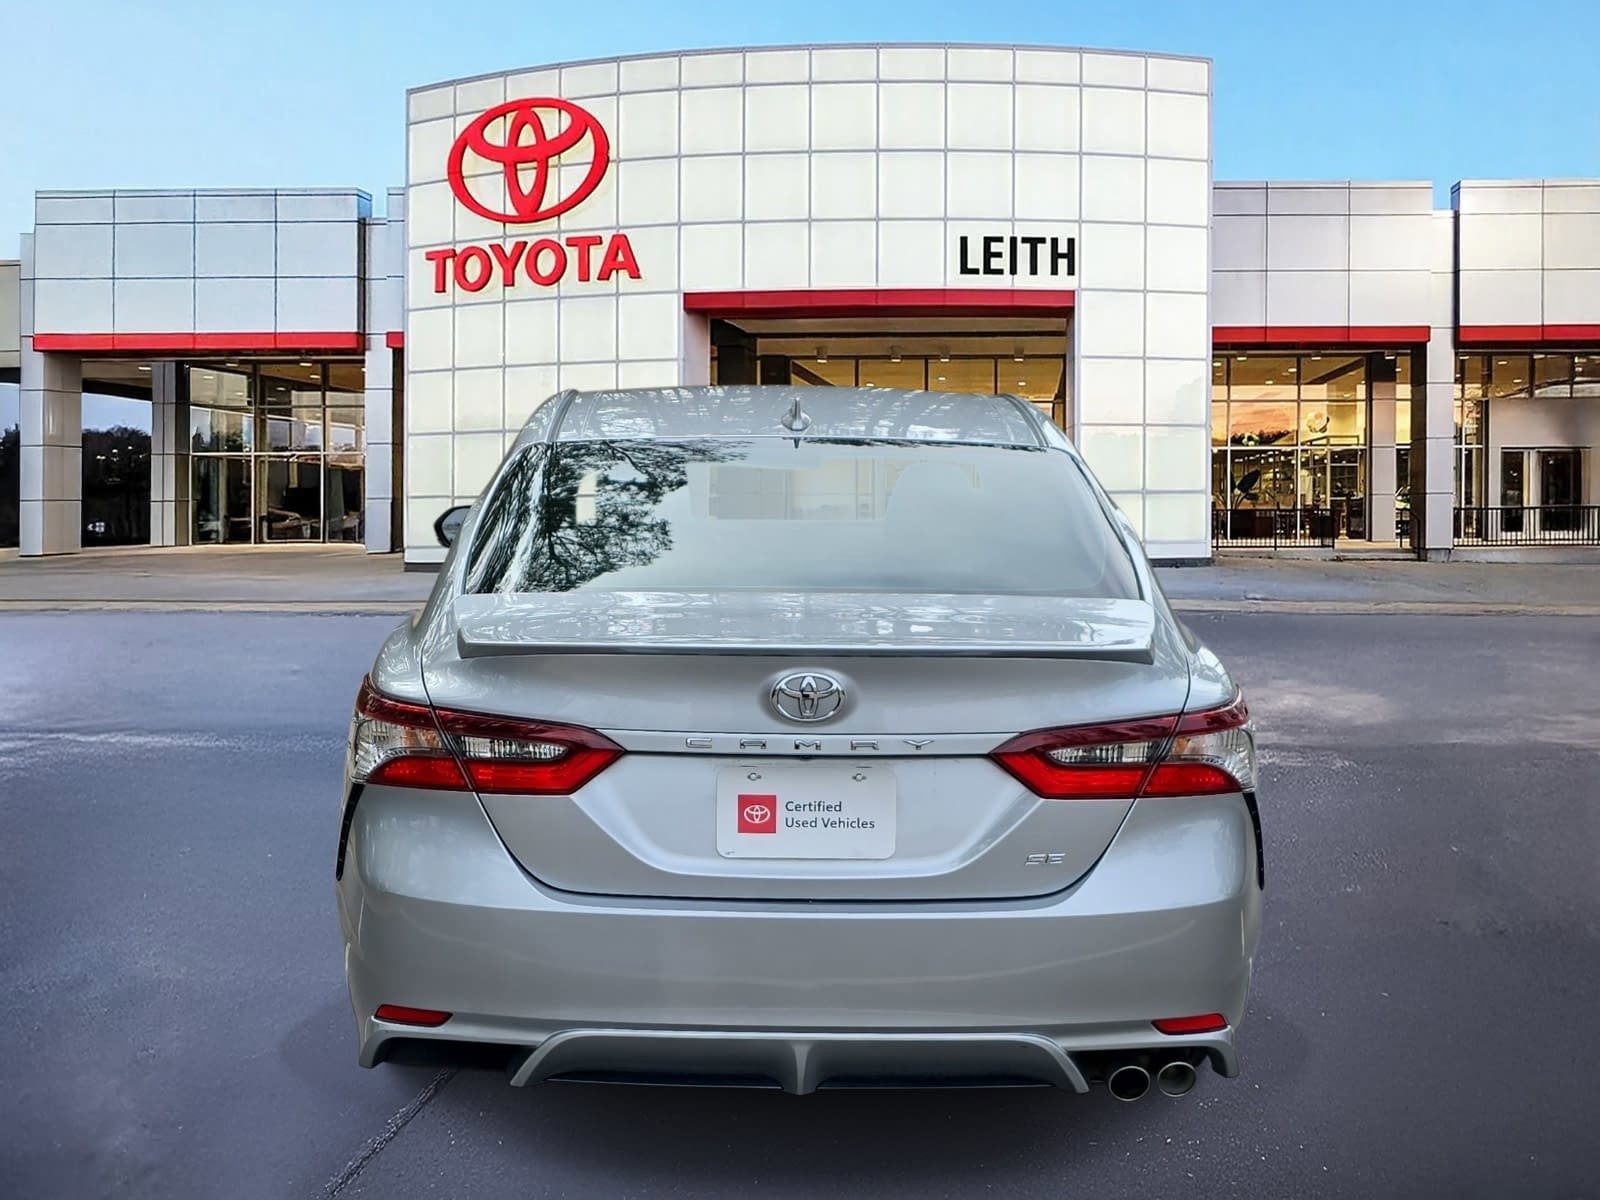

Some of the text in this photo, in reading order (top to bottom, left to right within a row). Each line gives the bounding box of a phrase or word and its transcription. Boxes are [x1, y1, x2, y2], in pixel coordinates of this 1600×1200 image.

[959, 236, 1076, 276] LEITH
[425, 234, 642, 293] TOYOTA
[685, 737, 935, 750] CAMRY
[785, 801, 842, 813] Certified
[785, 818, 875, 829] Used Vehicles
[1025, 853, 1066, 865] SE
